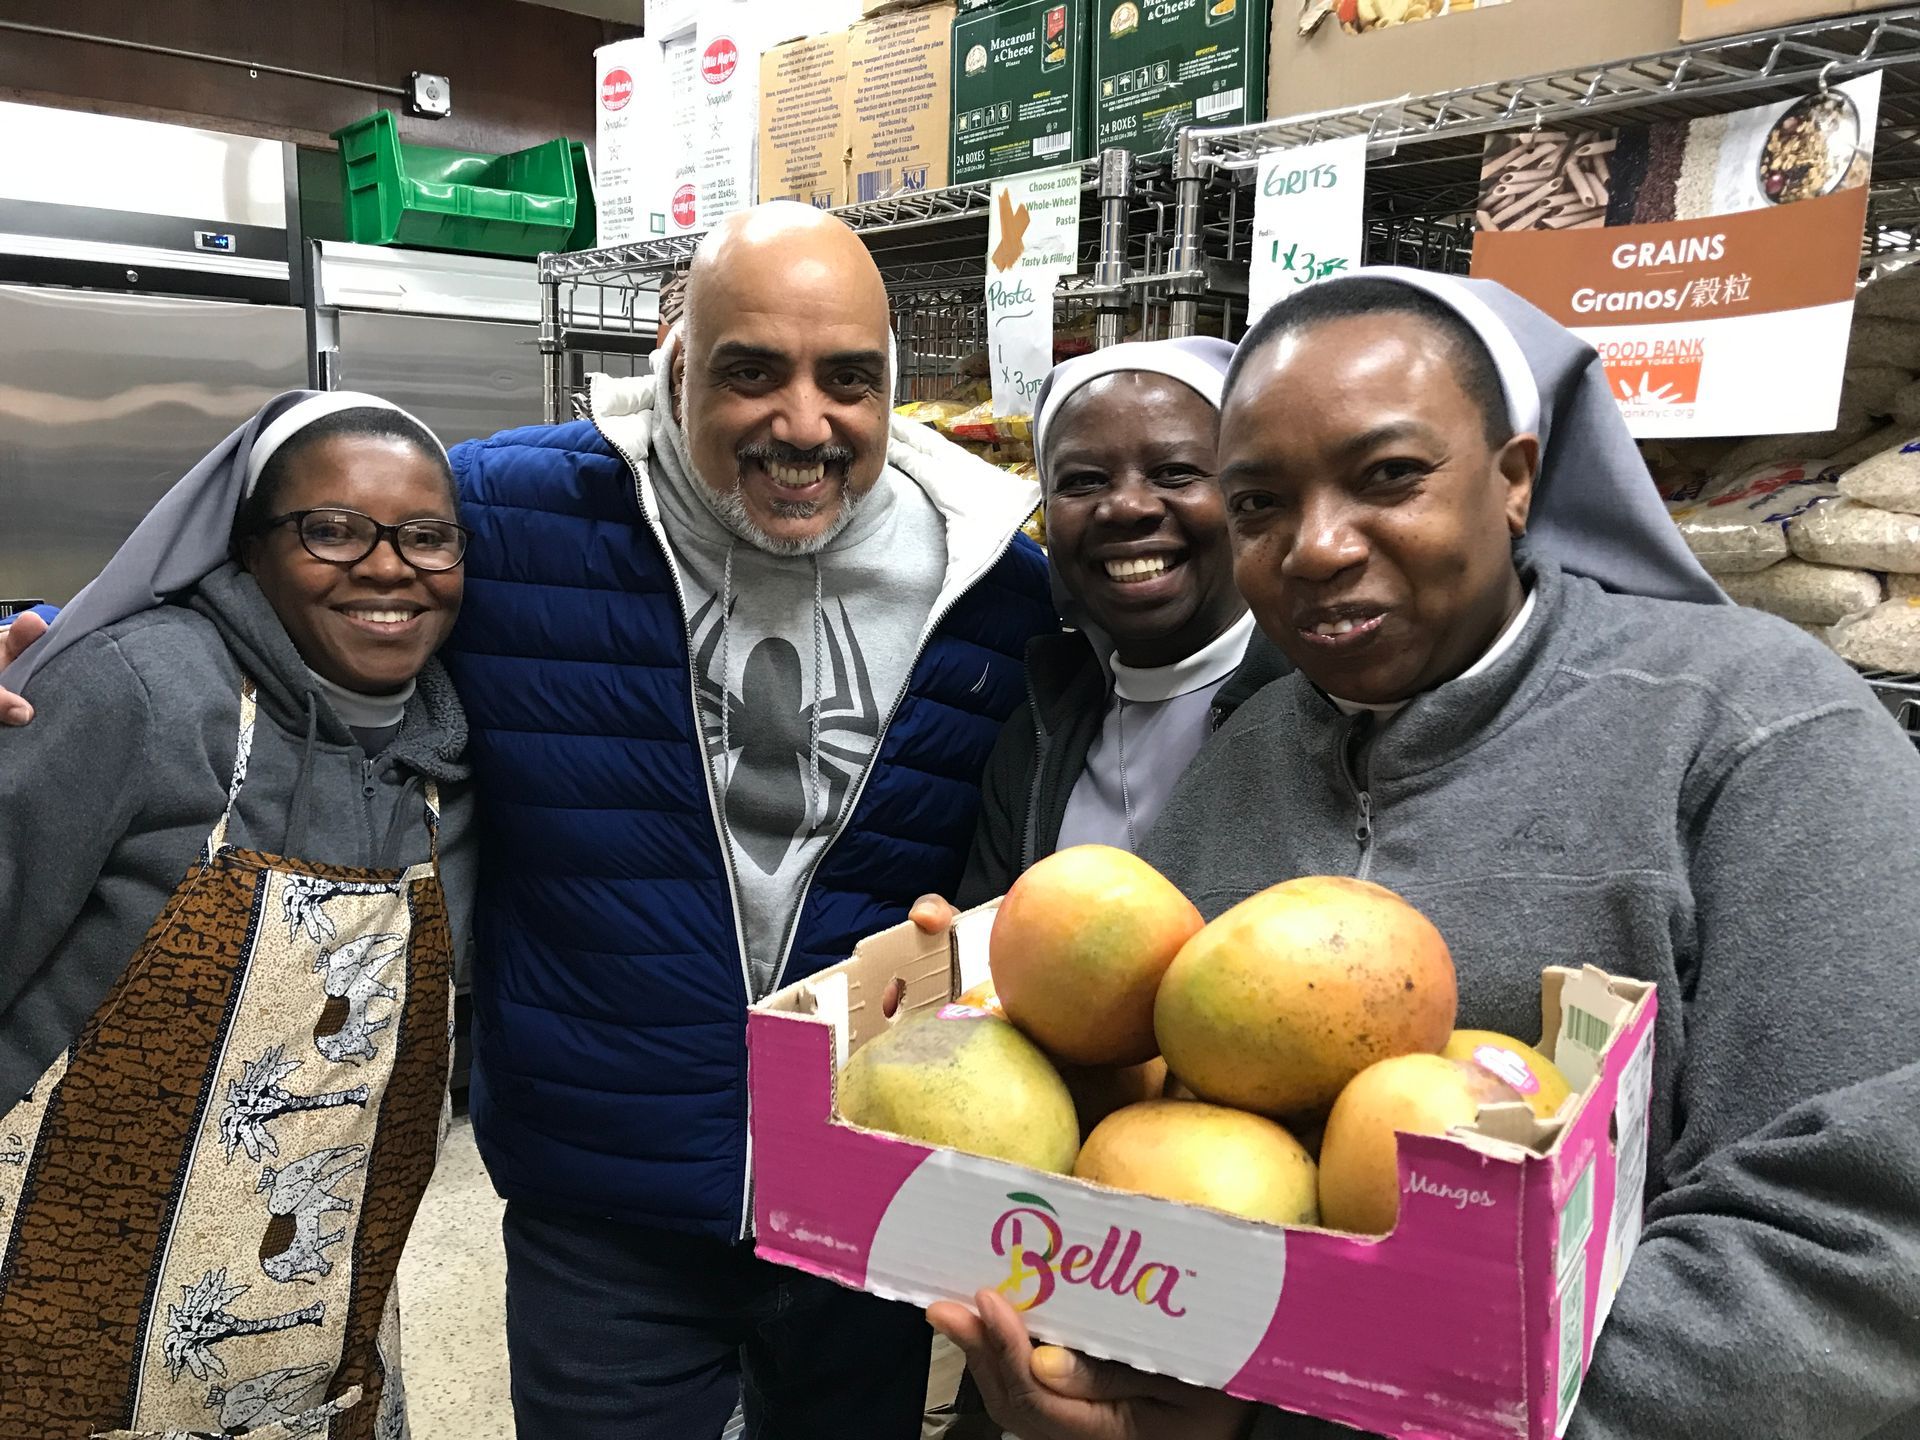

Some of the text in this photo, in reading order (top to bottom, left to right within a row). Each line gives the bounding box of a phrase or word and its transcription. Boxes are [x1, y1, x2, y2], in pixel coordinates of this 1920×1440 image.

[990, 28, 1036, 52] Macaroni
[1100, 123, 1111, 136] 24
[1112, 115, 1137, 133] BOXES
[957, 153, 965, 167] 24
[966, 149, 985, 165] BOXES
[1029, 176, 1078, 192] Choose 100%
[1263, 163, 1337, 197] GRITS
[1026, 195, 1077, 211] Whole-Wheat
[1055, 216, 1076, 226] Pasta
[1021, 252, 1075, 267] Tasty & Filling!
[1612, 234, 1726, 269] GRAINS
[988, 279, 1035, 311] Pasta
[1598, 338, 1704, 359] FOOD BANK
[1620, 359, 1643, 367] NEW
[1648, 357, 1674, 366] YORK
[1678, 355, 1704, 364] CITY
[1403, 1171, 1496, 1209] Mangos
[991, 1207, 1187, 1317] Bella
